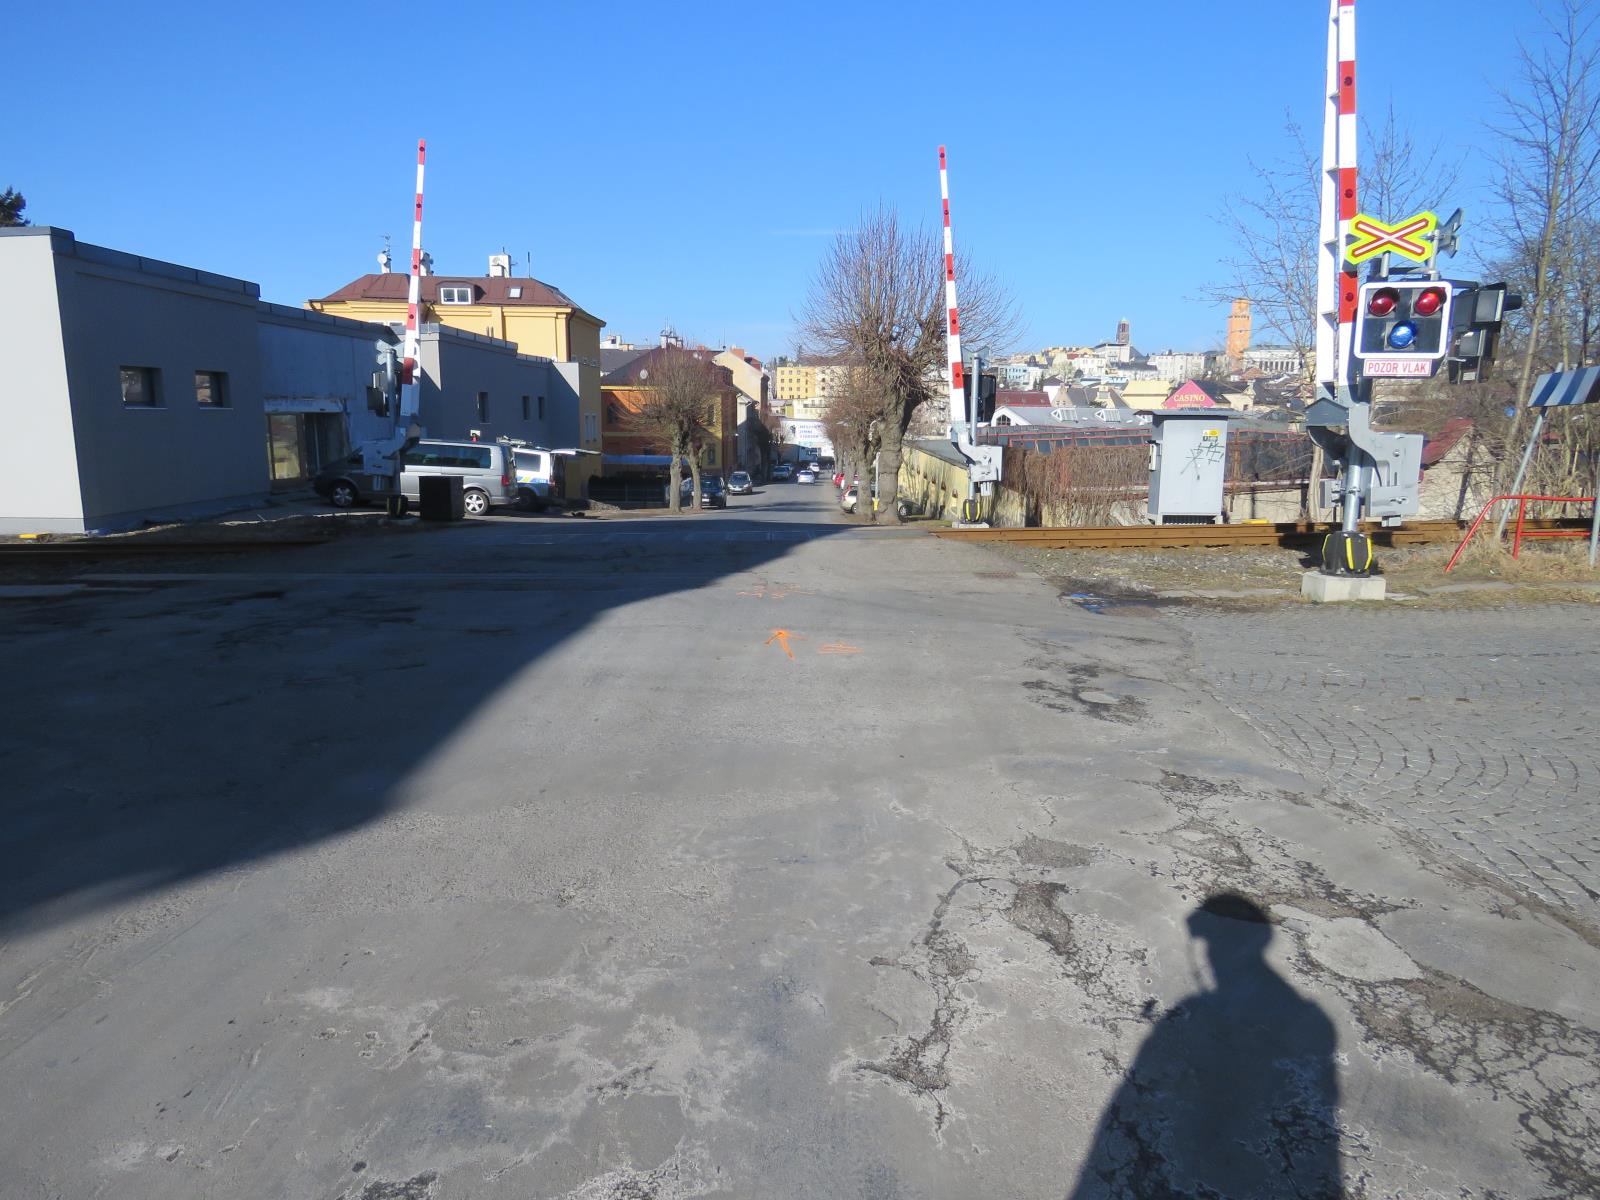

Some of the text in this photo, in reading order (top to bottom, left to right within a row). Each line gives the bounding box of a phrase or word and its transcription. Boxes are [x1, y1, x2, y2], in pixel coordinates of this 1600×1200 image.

[1368, 362, 1427, 373] POZOR VLAK
[1173, 394, 1205, 402] CASINO
